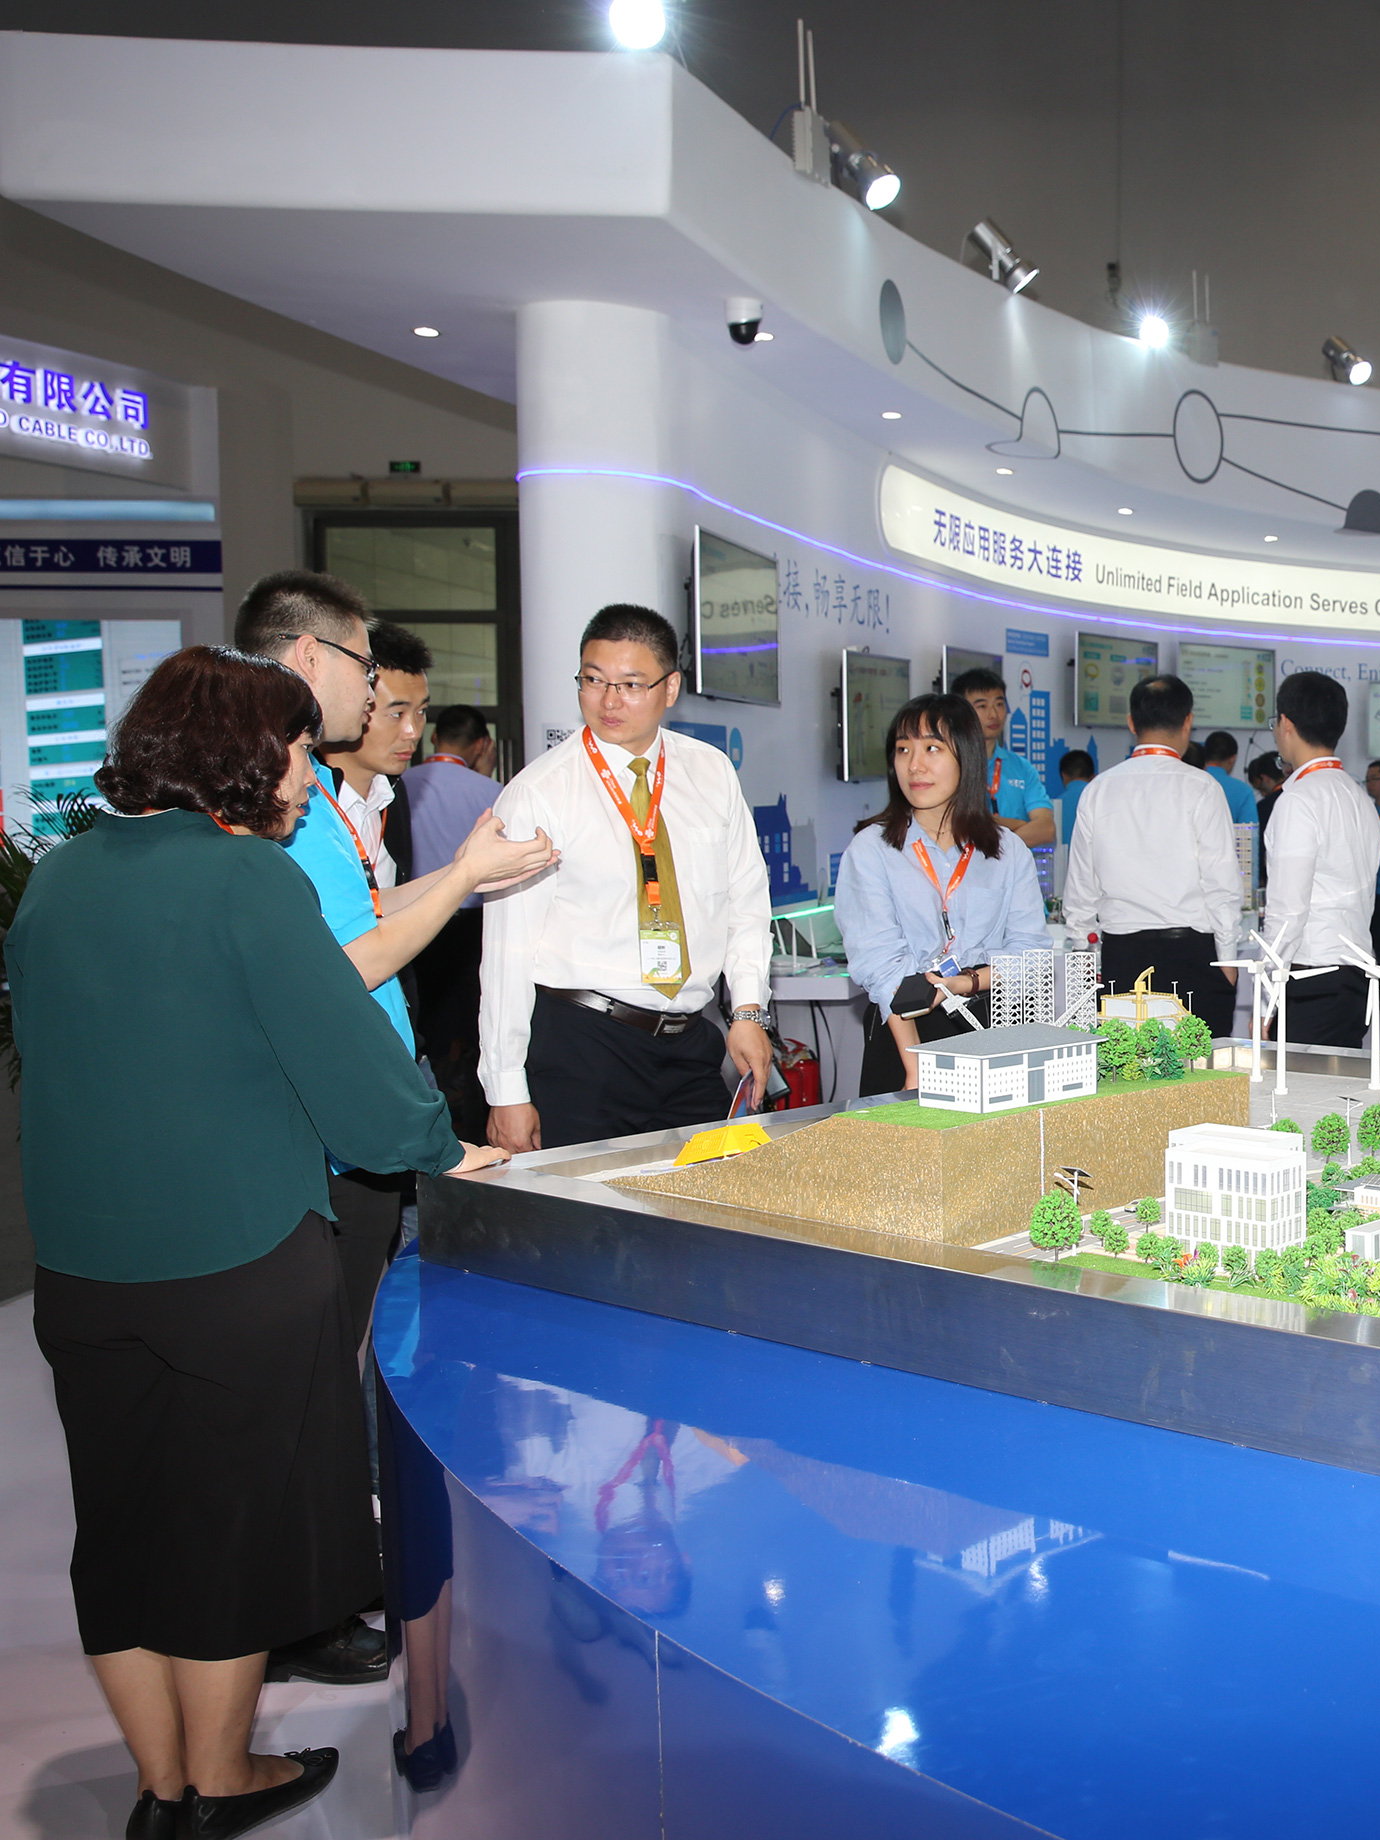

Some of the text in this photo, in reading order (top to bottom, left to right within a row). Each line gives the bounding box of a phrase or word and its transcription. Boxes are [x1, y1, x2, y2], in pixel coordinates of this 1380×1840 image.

[0, 361, 148, 430] 有限公司
[18, 416, 77, 442] CABLE
[0, 545, 192, 568] 信于心 传承文明
[933, 508, 1083, 583] 无限应用服务大连接
[1096, 563, 1162, 593] Unlimited
[1167, 576, 1203, 600] Field
[1207, 583, 1303, 610] Application
[1309, 593, 1368, 614] Serves
